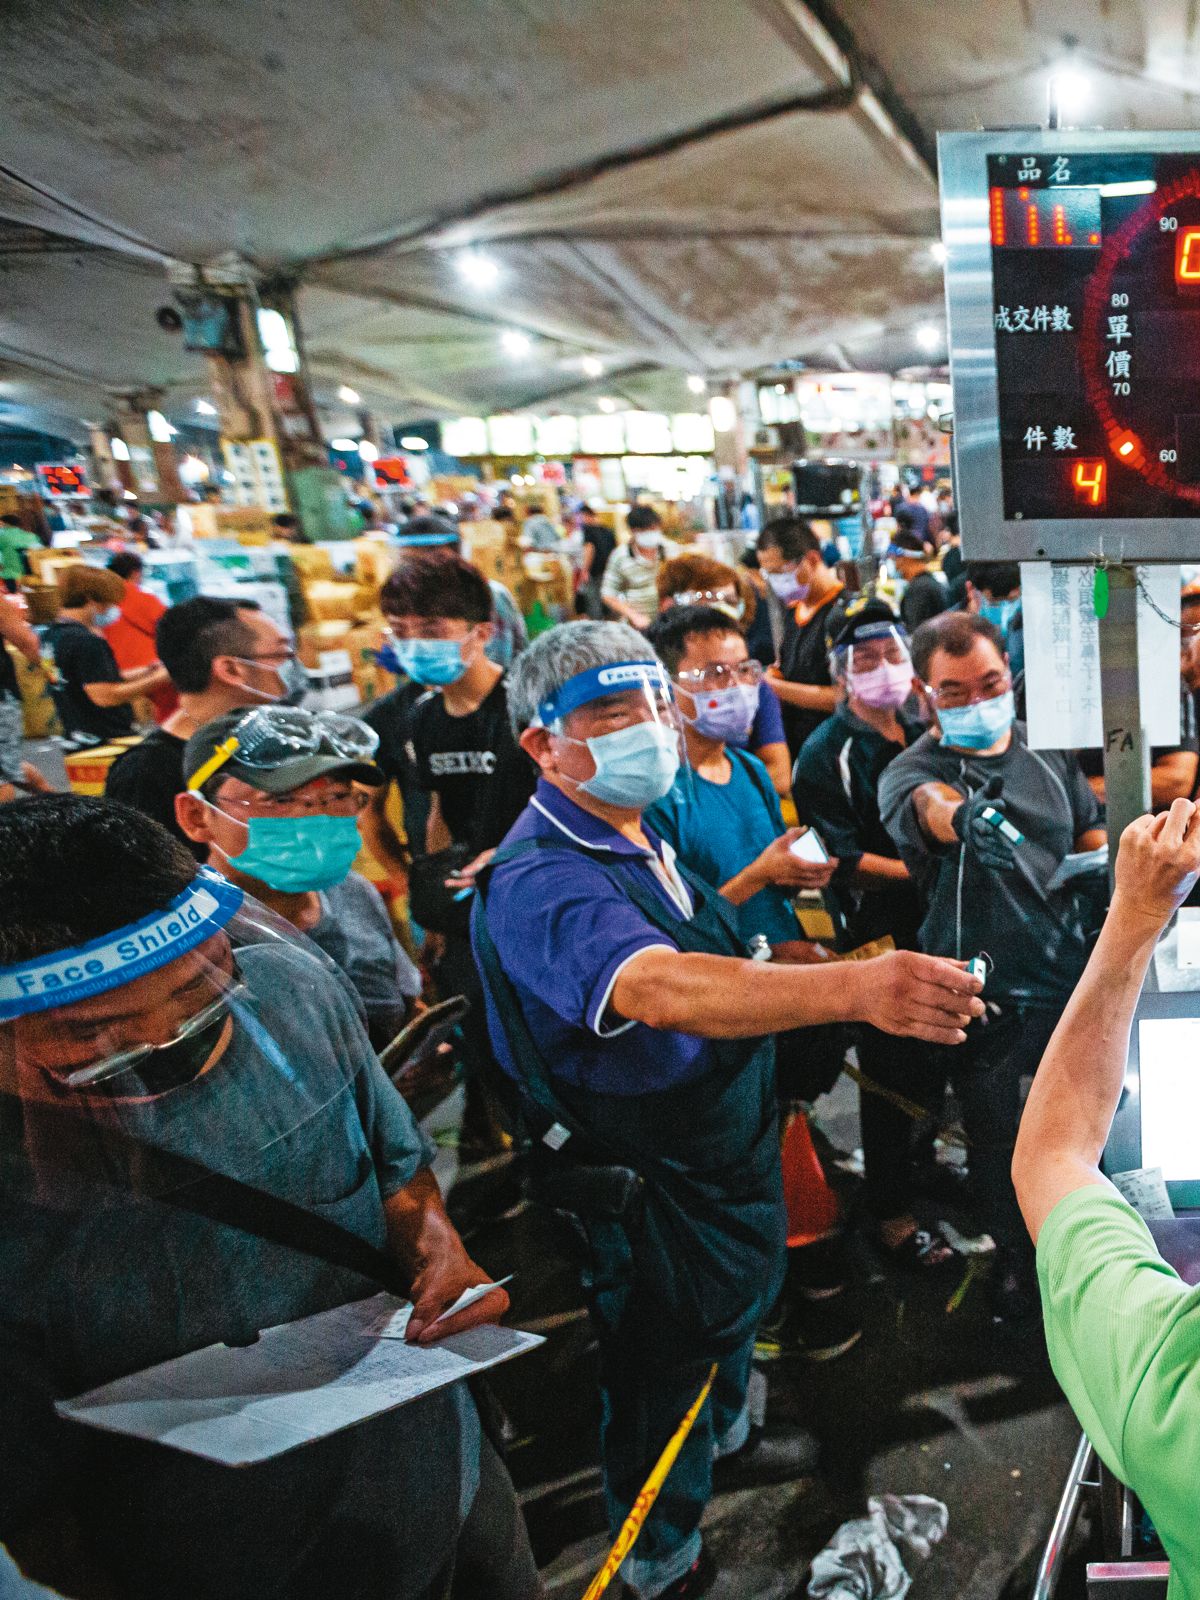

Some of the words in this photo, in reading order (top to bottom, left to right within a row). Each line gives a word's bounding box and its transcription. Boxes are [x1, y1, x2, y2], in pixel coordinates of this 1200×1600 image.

[1017, 155, 1071, 182] 品名
[1159, 216, 1178, 232] 90
[1111, 292, 1129, 307] 80
[994, 304, 1074, 333] 成交件數
[1105, 314, 1132, 379] 單價
[1112, 382, 1131, 396] 70
[1023, 425, 1078, 451] 件數
[1159, 449, 1177, 463] 60
[1075, 463, 1103, 502] 4
[1105, 728, 1134, 752] FA
[15, 958, 105, 995] Face
[116, 904, 201, 962] Shield
